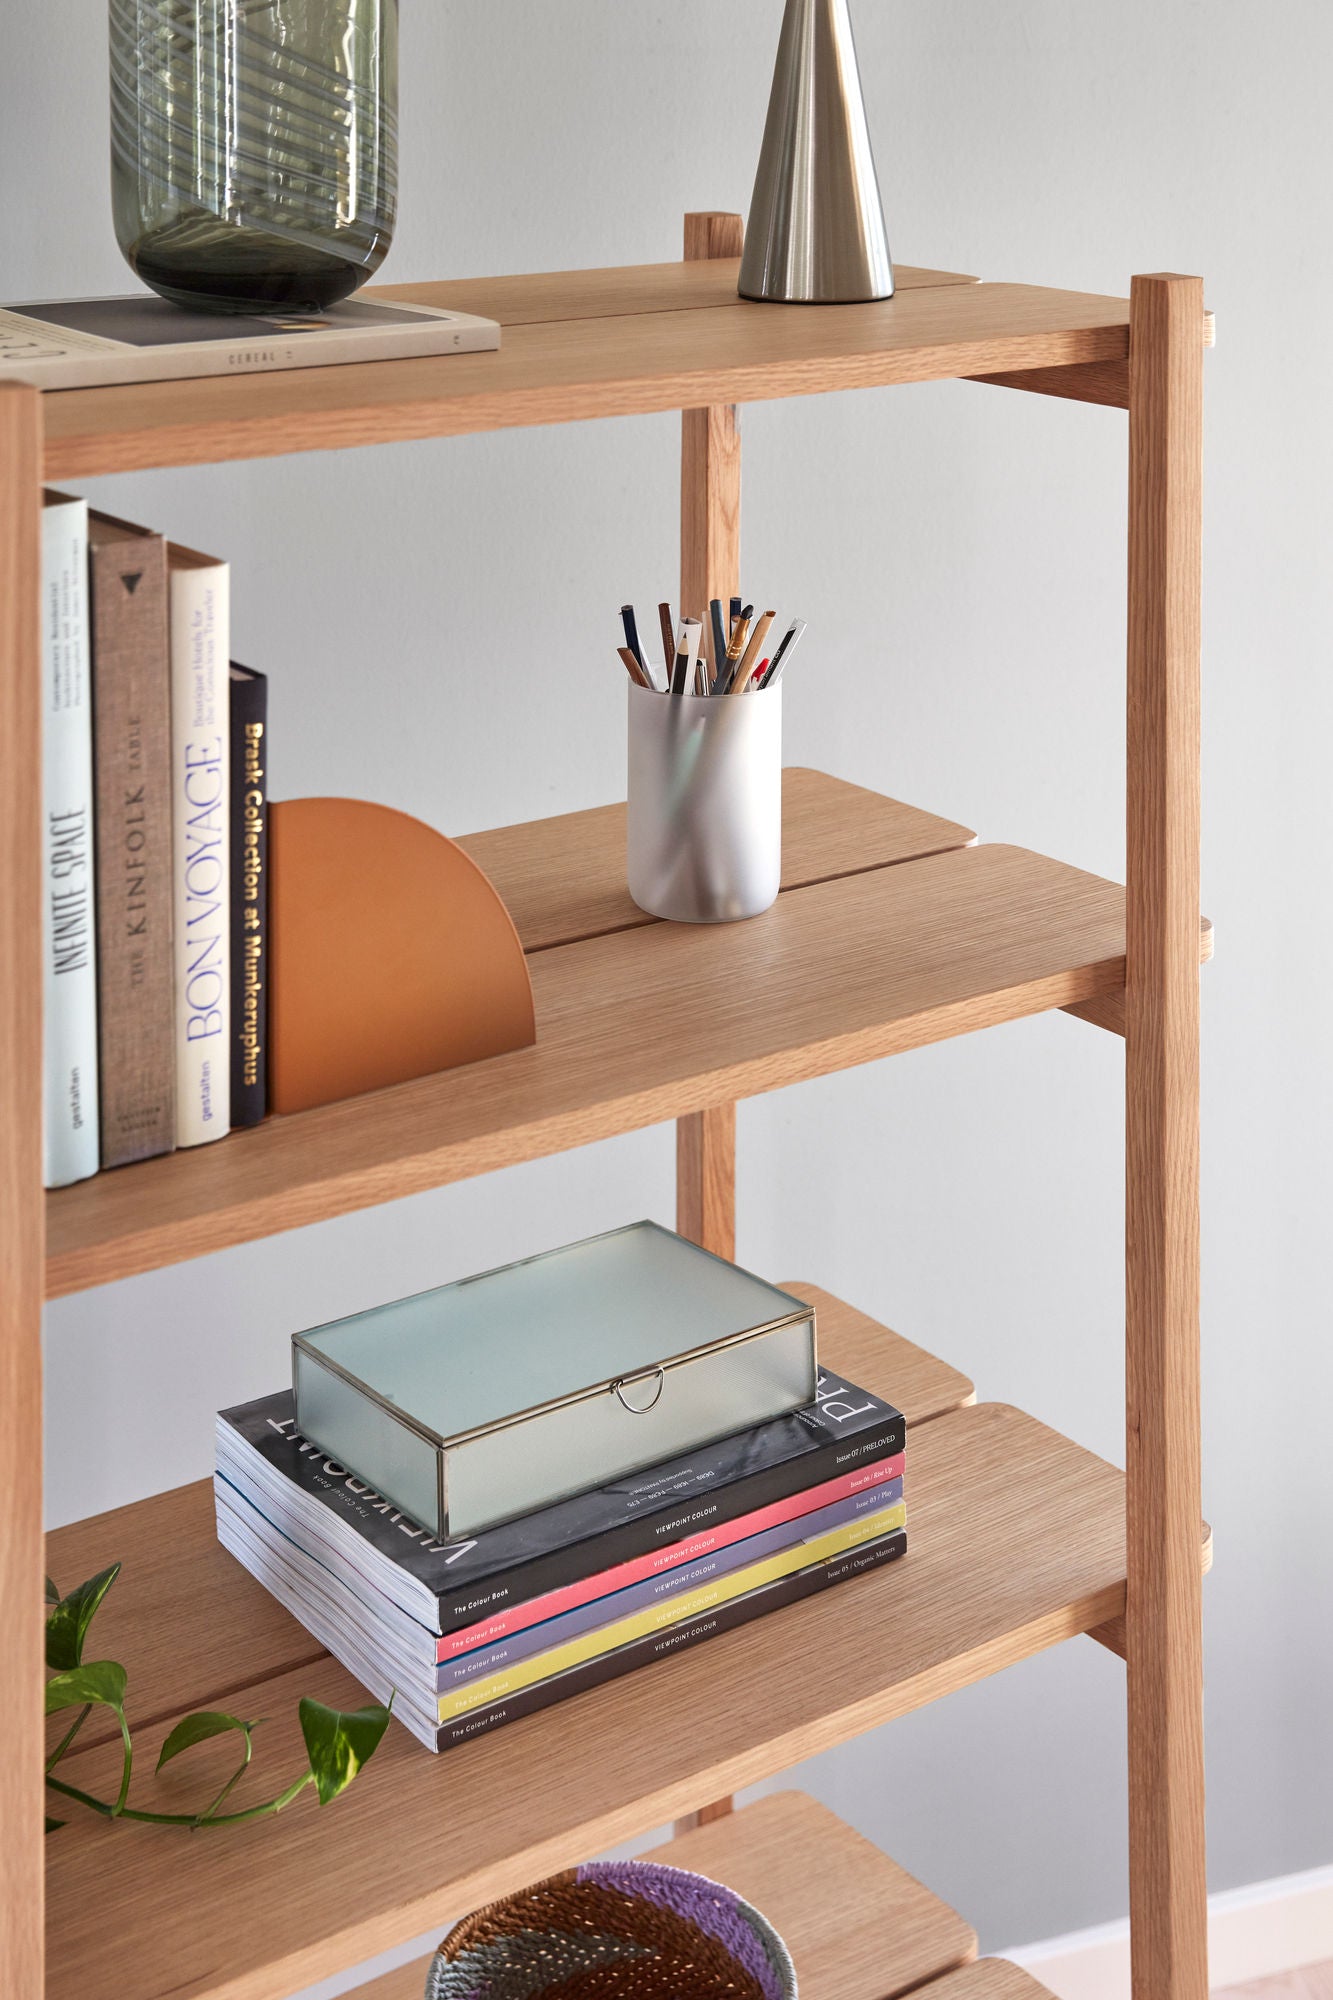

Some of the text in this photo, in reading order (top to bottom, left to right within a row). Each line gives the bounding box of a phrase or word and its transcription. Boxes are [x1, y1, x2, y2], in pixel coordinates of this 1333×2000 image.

[125, 785, 147, 937] KINFOLK
[50, 804, 88, 976] INFINITE SPACE
[184, 736, 223, 1042] BON VOYAGE
[239, 722, 263, 1087] Brask Collection at Munkeruphus
[69, 1066, 84, 1130] gestalten
[200, 1060, 214, 1122] gestalten
[836, 1454, 851, 1463] Issue
[851, 1449, 859, 1458] 07
[863, 1434, 896, 1453] PRELOVED
[850, 1479, 863, 1488] Issue
[874, 1471, 884, 1480] Rise
[884, 1467, 893, 1475] Up
[312, 1473, 370, 1519] The Colour Book
[856, 1501, 869, 1509] Issue
[881, 1490, 893, 1499] Play
[655, 1505, 718, 1535] VIEWPOINT COLOUR
[653, 1537, 716, 1568] VIEWPOINT COLOUR
[827, 1569, 840, 1579] Issue
[854, 1555, 875, 1568] Organic
[875, 1547, 896, 1559] Matters
[654, 1563, 716, 1593] VIEWPOINT COLOUR
[454, 1588, 509, 1614] The Colour Book
[452, 1622, 506, 1649] The Colour Book
[654, 1620, 717, 1651] VIEWPOINT COLOUR
[454, 1651, 508, 1678] The Colour Book
[452, 1711, 507, 1739] The Colour Book
